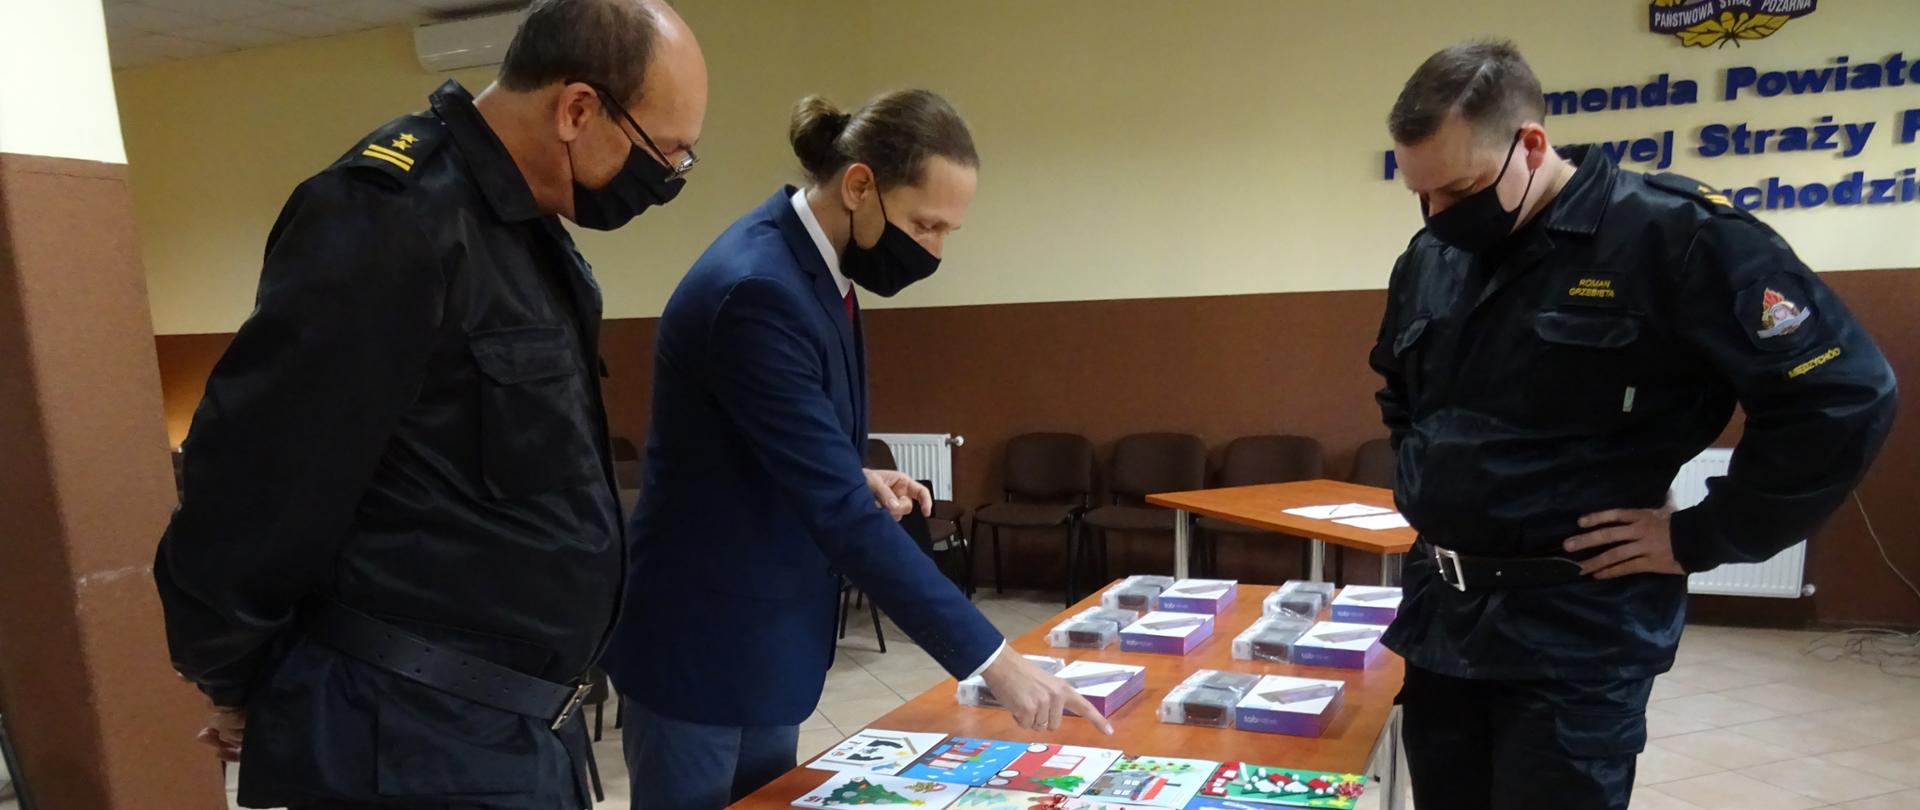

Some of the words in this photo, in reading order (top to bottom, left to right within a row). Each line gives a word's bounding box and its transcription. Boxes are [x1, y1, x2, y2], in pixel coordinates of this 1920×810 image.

[1654, 2, 1714, 28] PAŃSTWOWA
[1544, 73, 1698, 116] menda
[1698, 115, 1877, 158] Straży
[1722, 168, 1920, 211] chodzi
[1579, 279, 1611, 289] ROMAN
